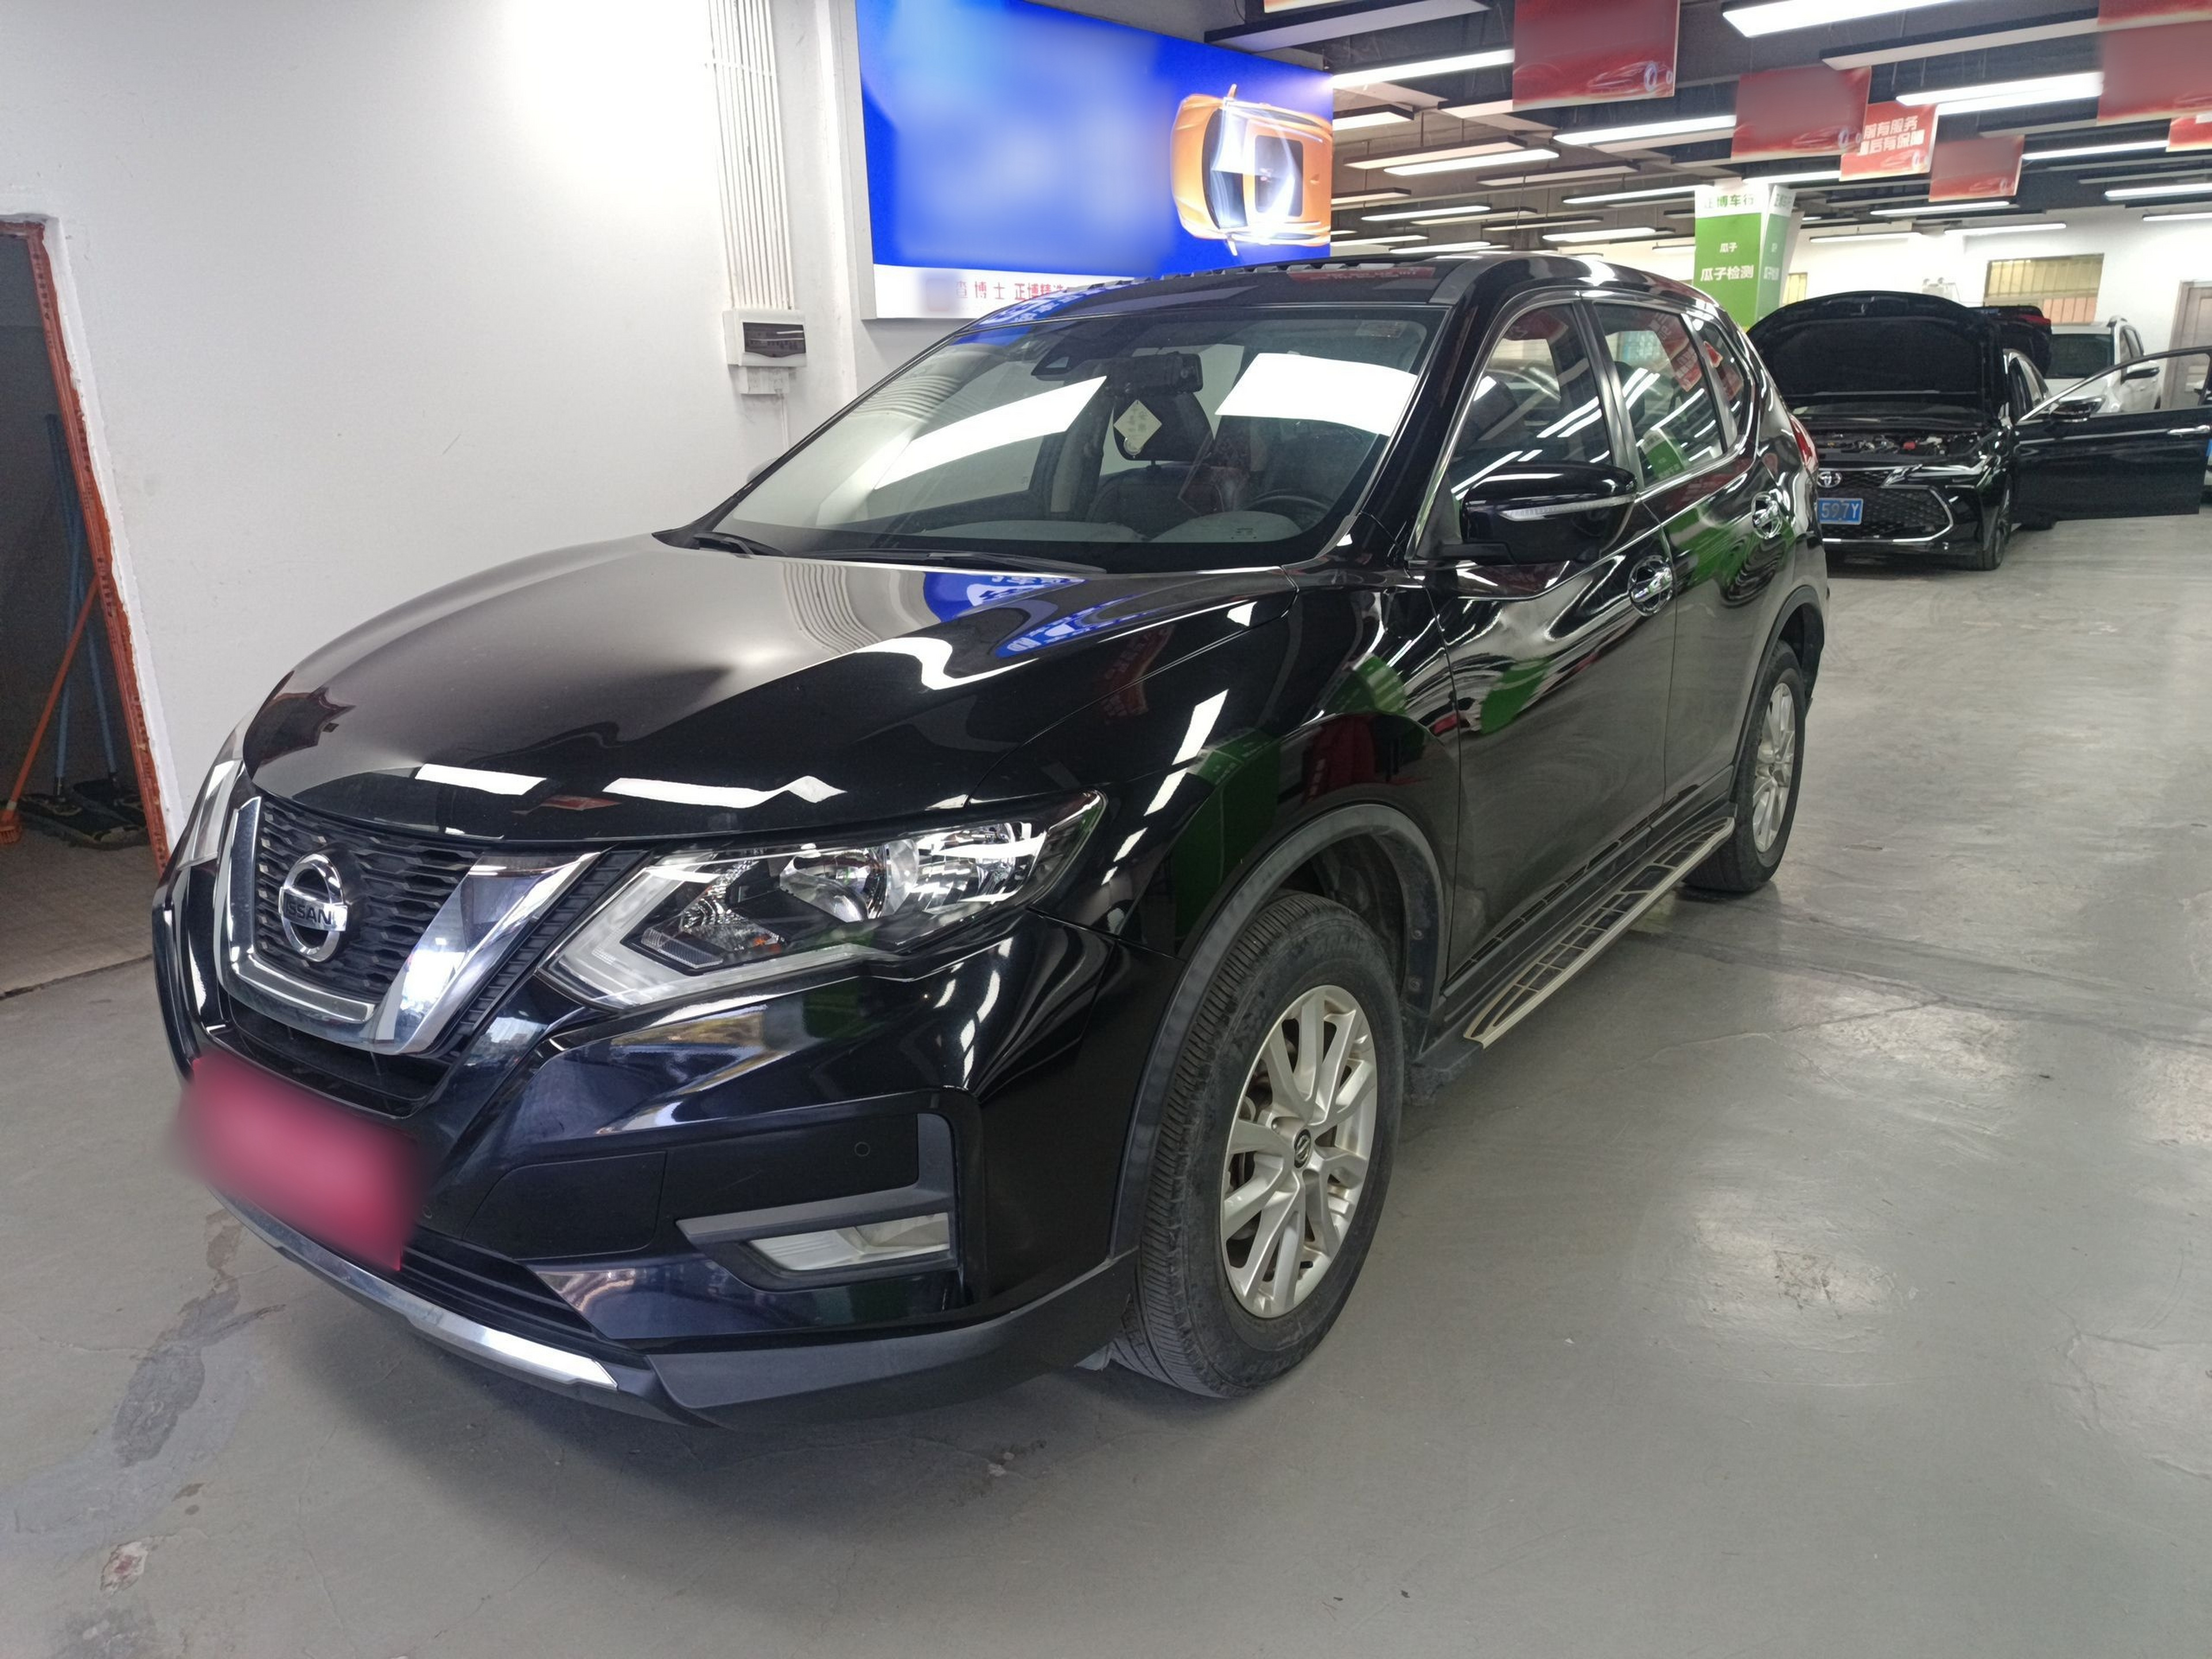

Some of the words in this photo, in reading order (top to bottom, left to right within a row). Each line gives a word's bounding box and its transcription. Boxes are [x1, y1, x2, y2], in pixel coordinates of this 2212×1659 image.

[1700, 265, 1755, 281] 瓜子检测
[286, 897, 332, 925] SSAN
